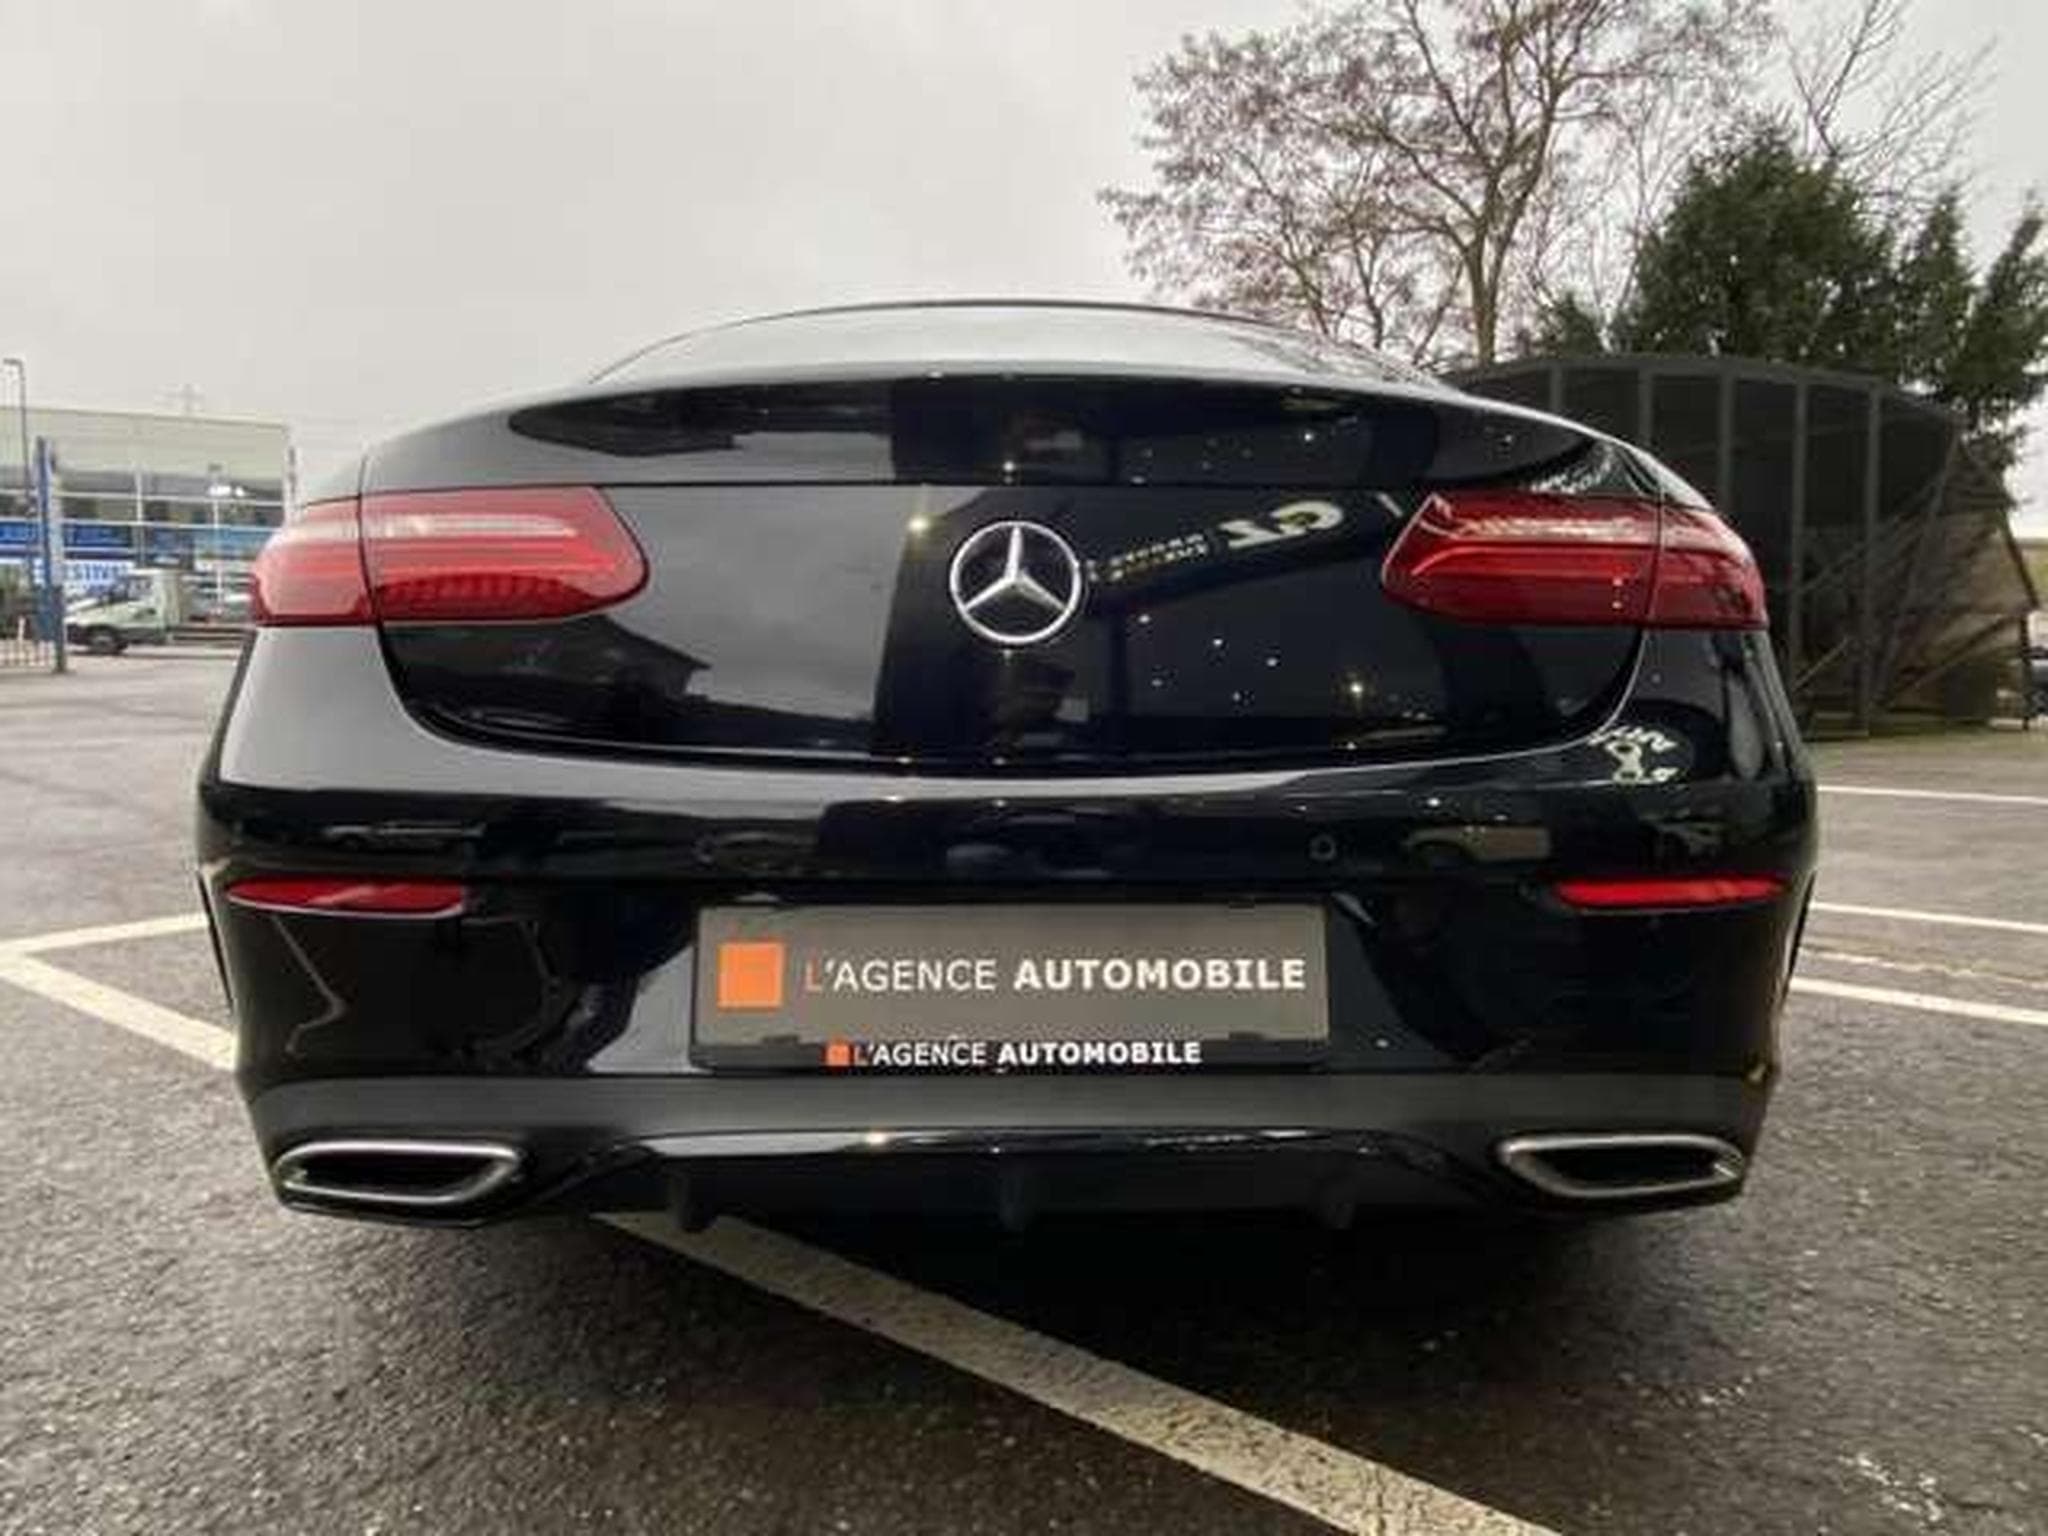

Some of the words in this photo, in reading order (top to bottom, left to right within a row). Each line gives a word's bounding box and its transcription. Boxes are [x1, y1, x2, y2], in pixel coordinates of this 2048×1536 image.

[805, 959, 996, 991] L'AGENCE
[1014, 958, 1306, 991] AUTOMOBILE
[854, 1041, 988, 1066] L'AGENCE
[996, 1041, 1203, 1065] AUTOMOBILE
